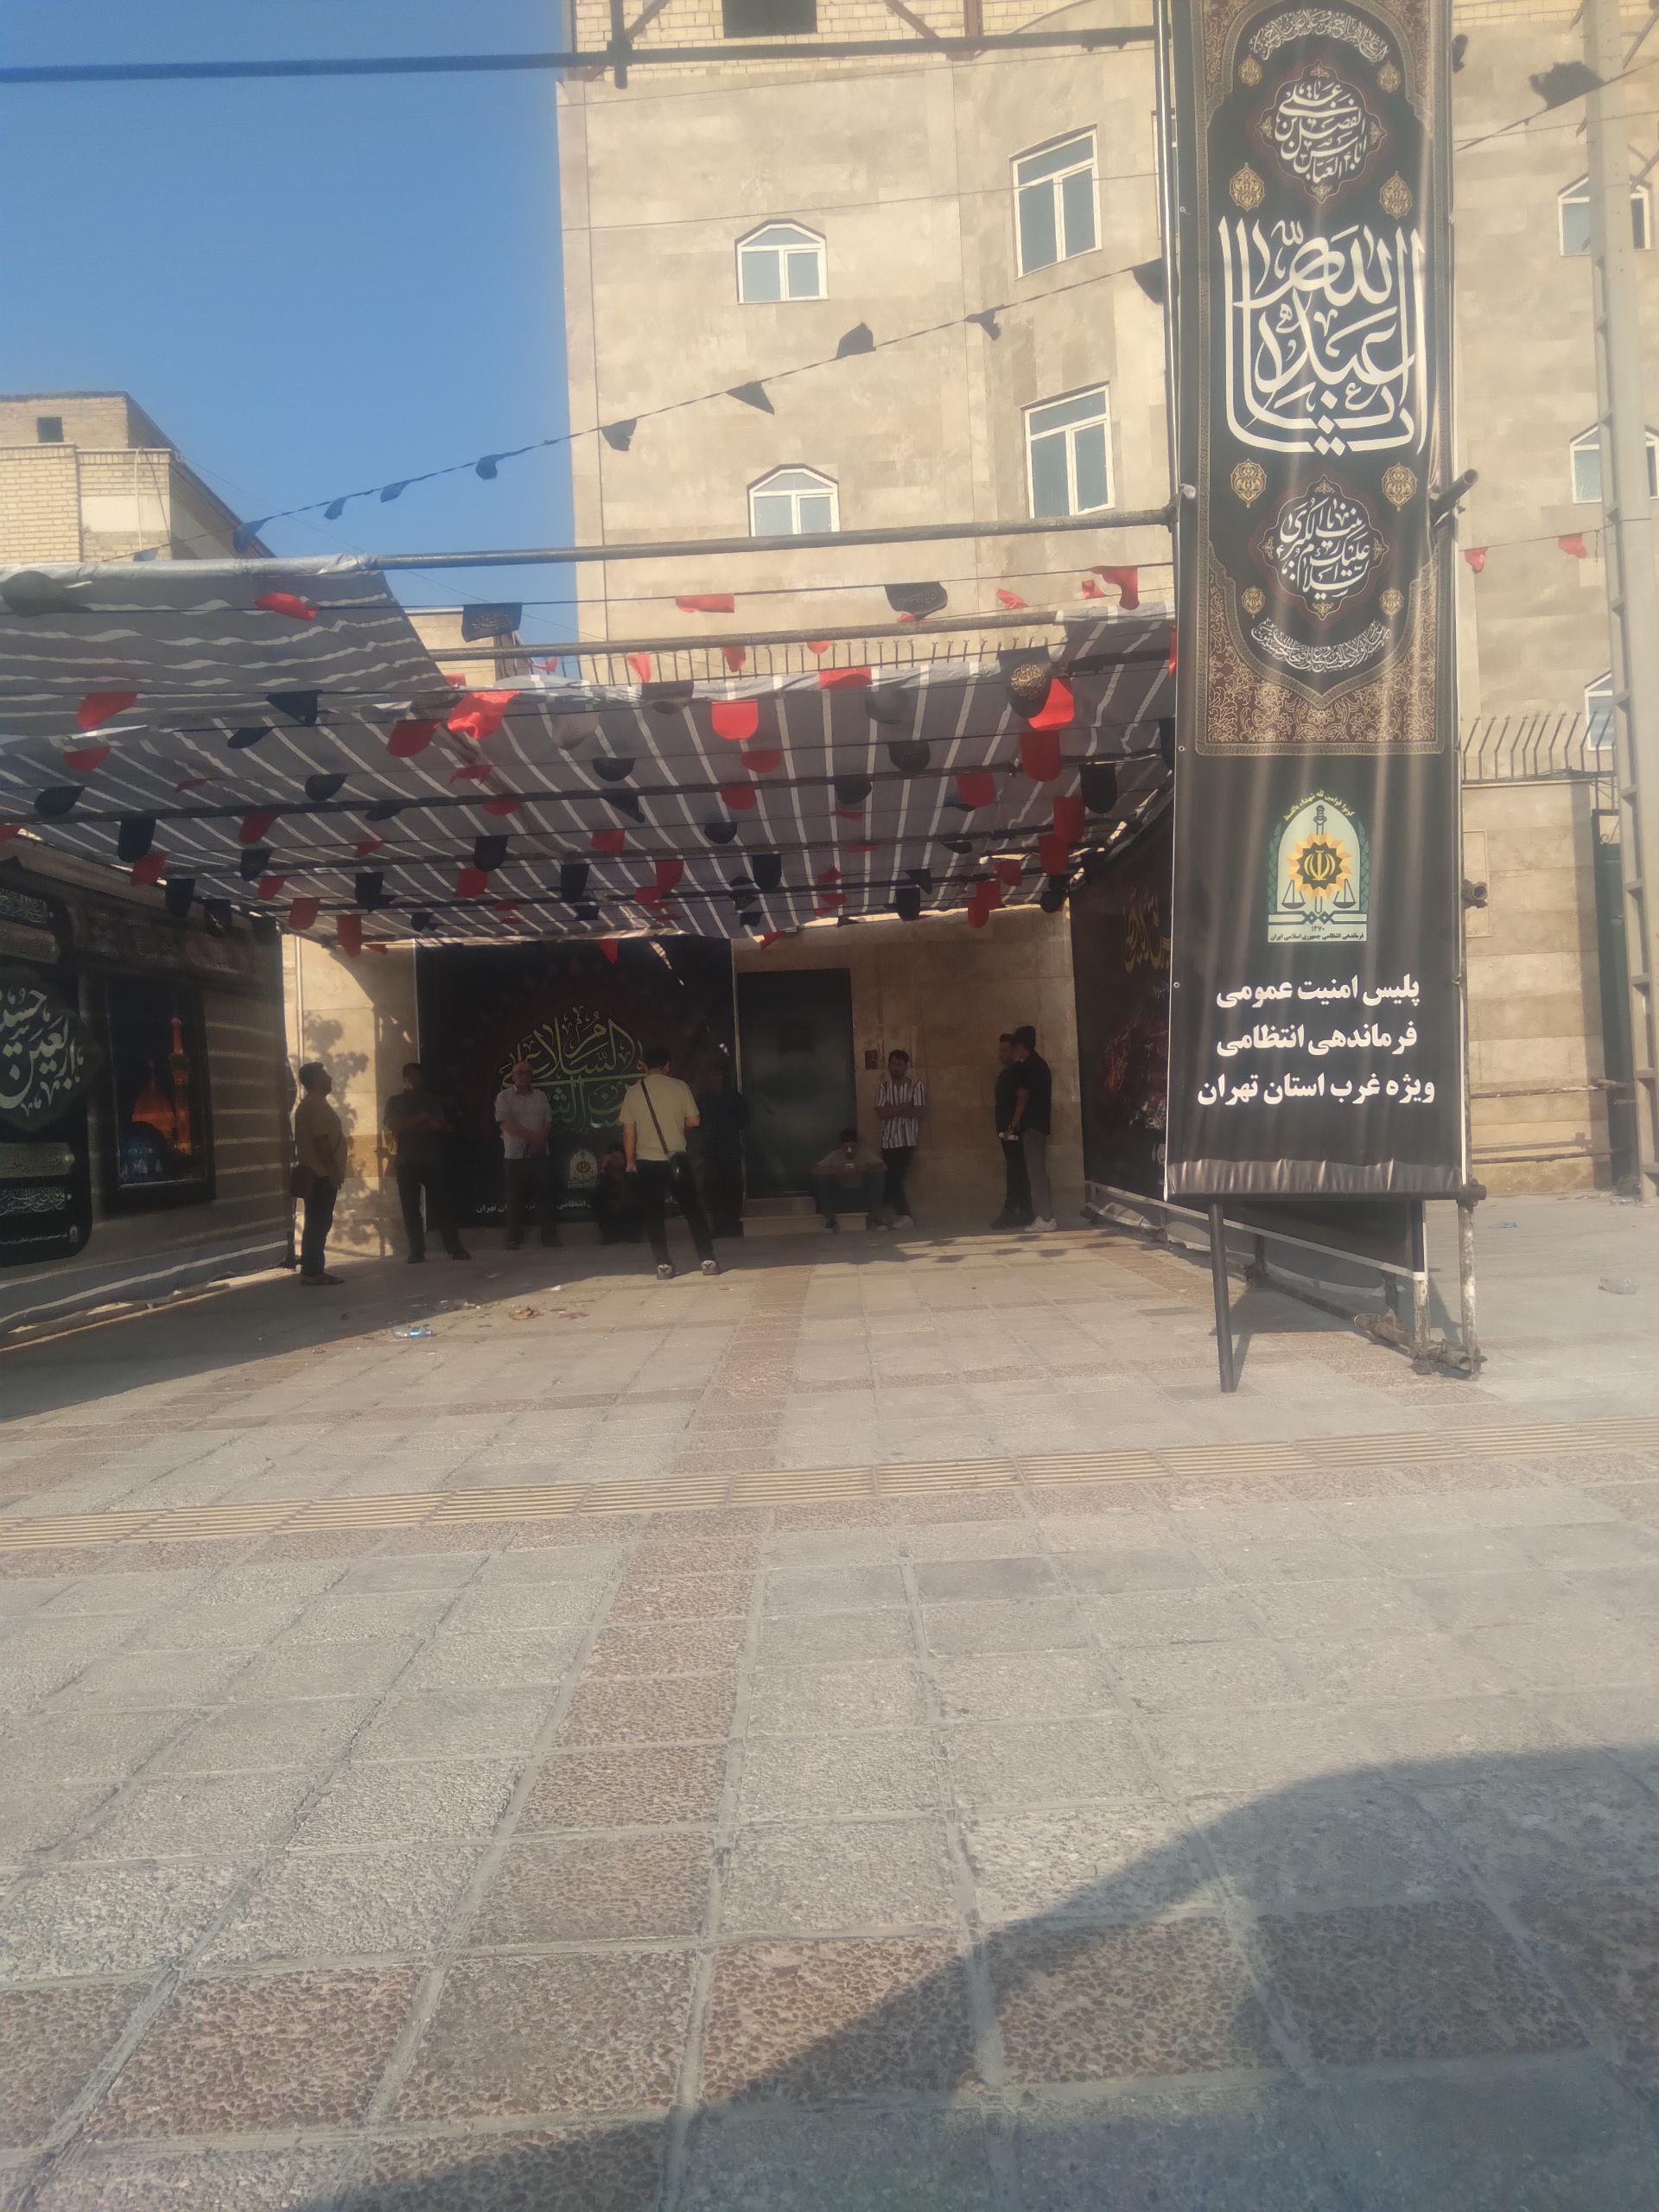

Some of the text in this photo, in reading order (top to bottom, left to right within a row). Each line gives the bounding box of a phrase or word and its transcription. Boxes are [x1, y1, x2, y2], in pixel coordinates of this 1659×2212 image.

[1270, 932, 1364, 942] فرماندهی انتظامی جمهوری اسلامی ایران
[1216, 973, 1420, 1008] پلیس امنیت عمومی
[1216, 1020, 1418, 1057] فرماندهی انتظامی
[1198, 1072, 1435, 1105] ویژه غرب استان تهران
